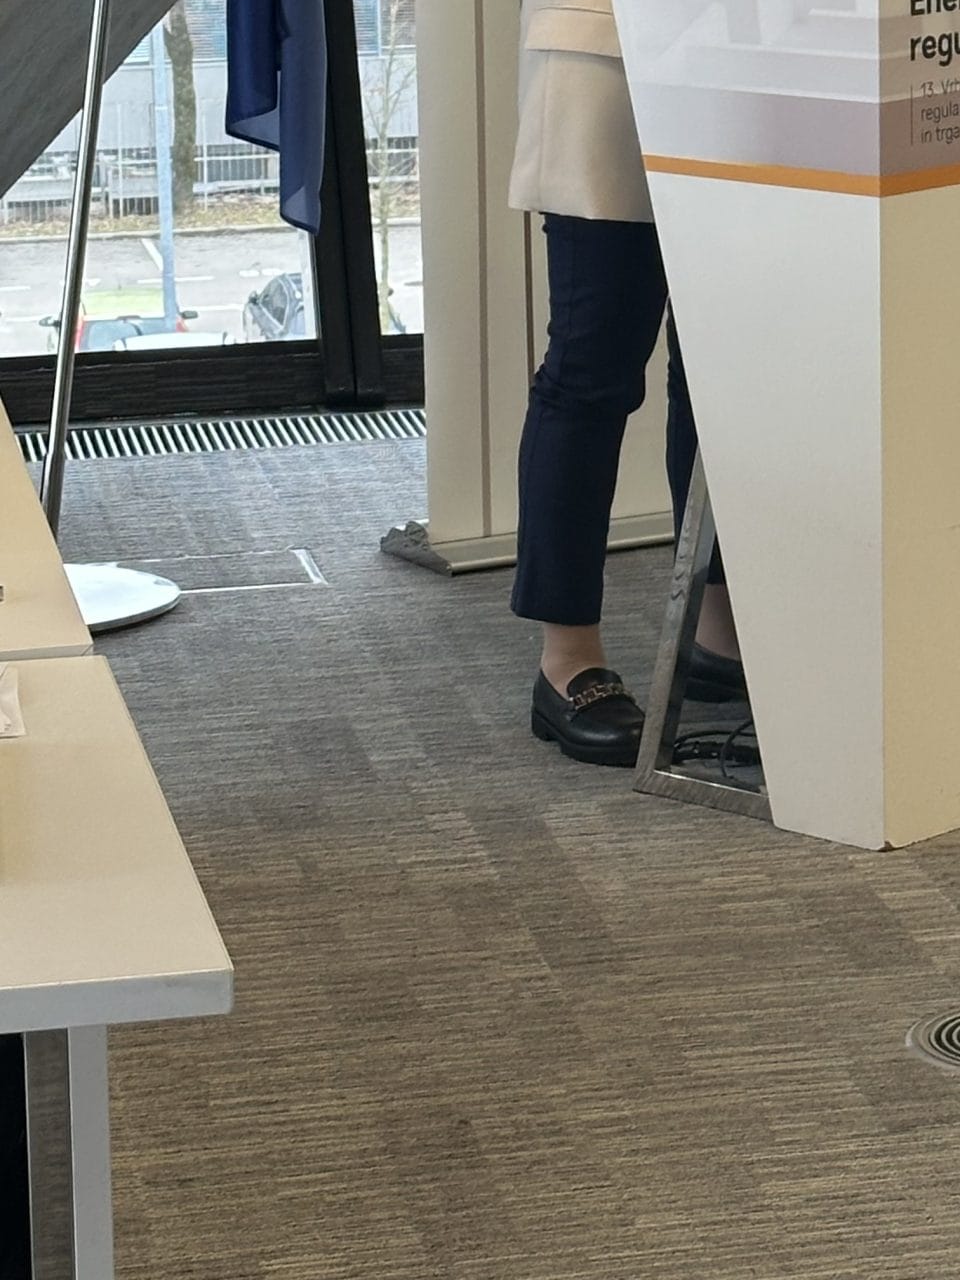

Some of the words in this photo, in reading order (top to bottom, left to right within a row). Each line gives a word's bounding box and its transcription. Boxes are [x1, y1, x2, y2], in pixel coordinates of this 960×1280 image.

[920, 81, 938, 98] 13.
[920, 128, 933, 144] in
[935, 125, 960, 145] trga
